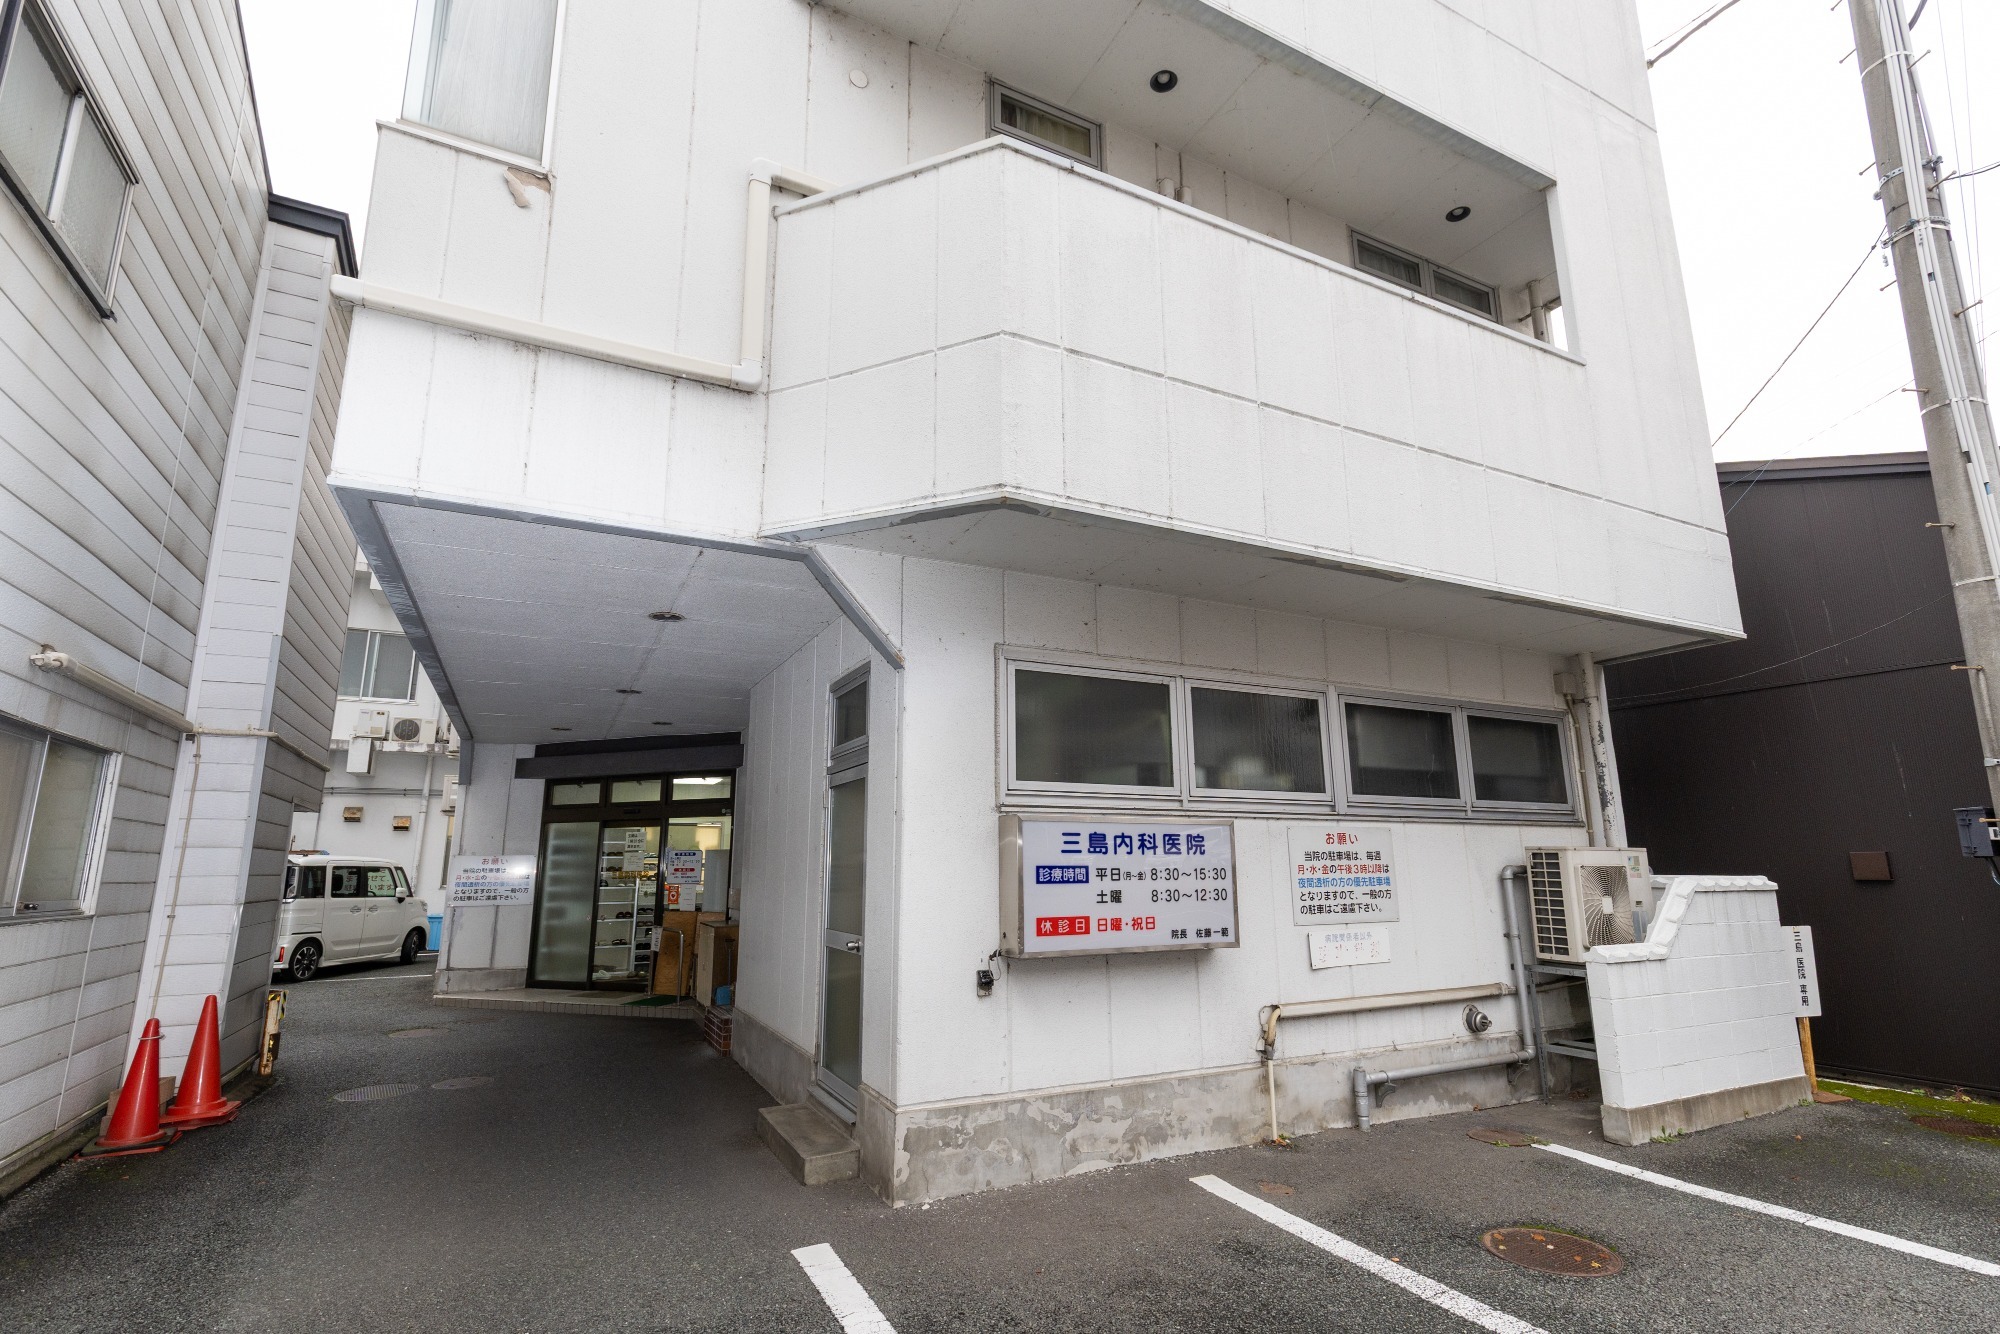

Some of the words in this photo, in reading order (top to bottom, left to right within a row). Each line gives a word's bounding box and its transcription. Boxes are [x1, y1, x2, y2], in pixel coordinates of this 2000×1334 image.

[1060, 831, 1206, 856] 三島内科医院
[1325, 832, 1359, 846] お願い
[1304, 850, 1382, 862] 当院の駐車場は、毎週
[1038, 867, 1087, 882] 診療時間
[1297, 875, 1391, 889] 夜間透析の方の優先駐車場
[1096, 889, 1122, 904] 土曜
[1299, 888, 1392, 902] となりますので、一般の方
[1300, 902, 1384, 915] の駐車はご遠慮下さい。
[1040, 918, 1087, 934] 休診日
[1097, 916, 1156, 932] 日曜・祝日
[1171, 929, 1188, 939] 院長
[1195, 927, 1229, 939] 佐藤一範
[1793, 931, 1803, 953] 三島
[1796, 957, 1807, 980] 医院
